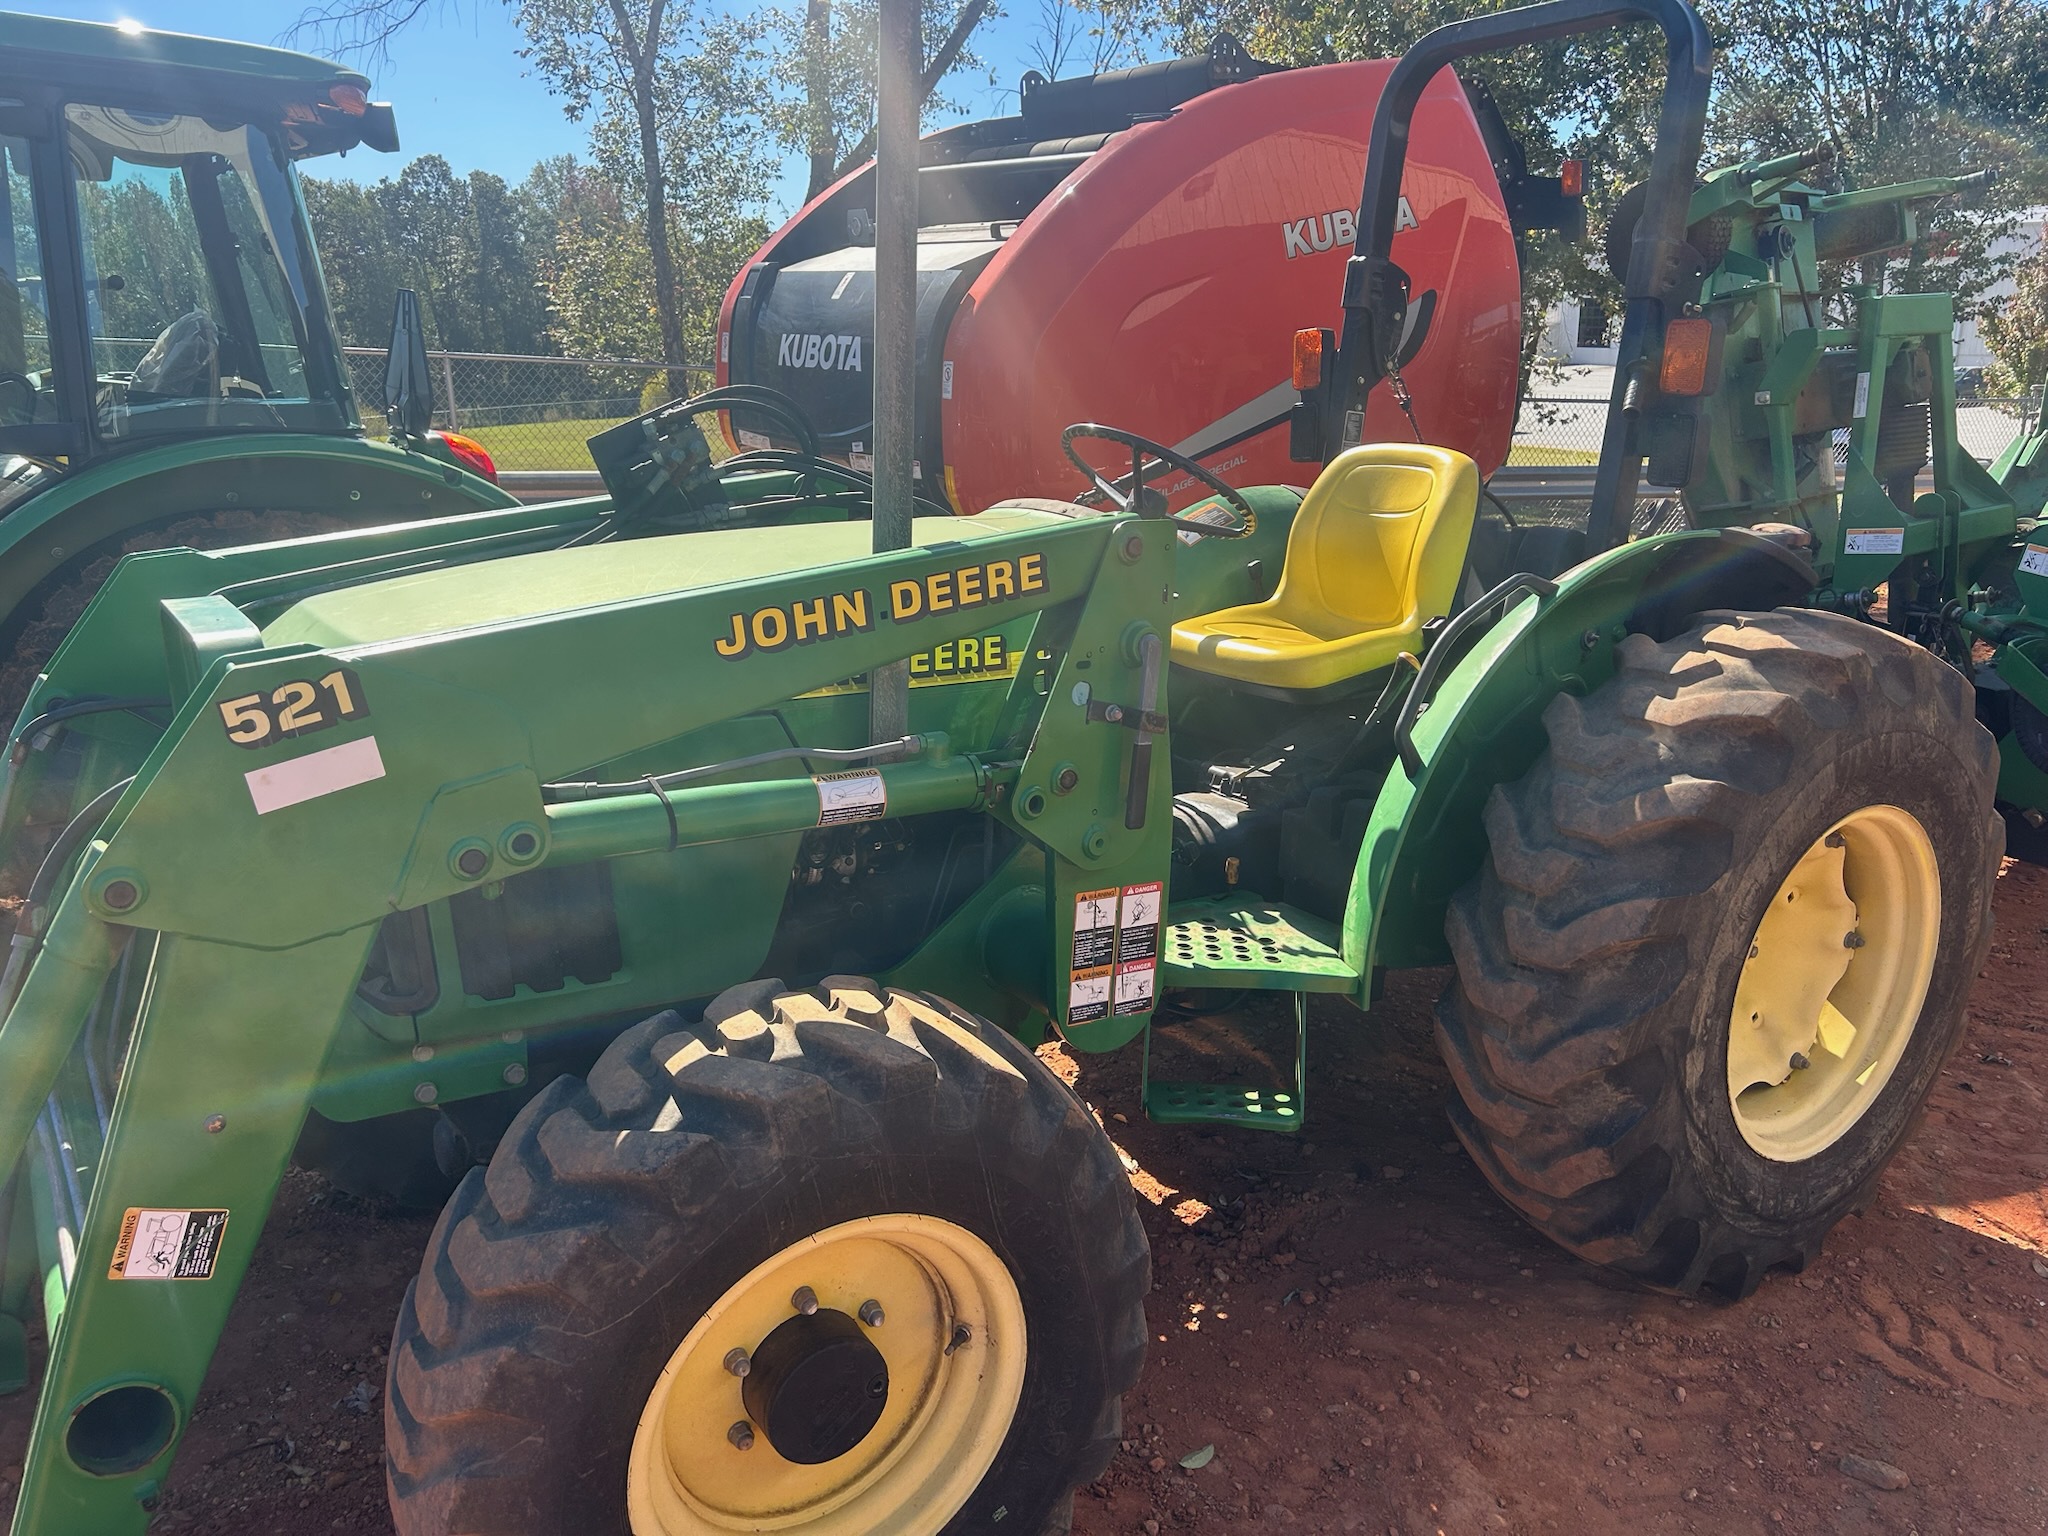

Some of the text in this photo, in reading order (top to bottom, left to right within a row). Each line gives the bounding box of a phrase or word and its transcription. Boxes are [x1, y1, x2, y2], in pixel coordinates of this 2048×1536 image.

[1282, 195, 1419, 259] KUBA
[777, 333, 862, 372] KUBOTA
[1208, 455, 1248, 475] PECIAL
[714, 552, 1046, 658] JOHN DEERE
[219, 670, 354, 744] 521
[826, 769, 878, 782] WARNING
[1134, 884, 1158, 894] DANGER
[1129, 962, 1152, 972] DANGER
[116, 1215, 137, 1259] WARNING
